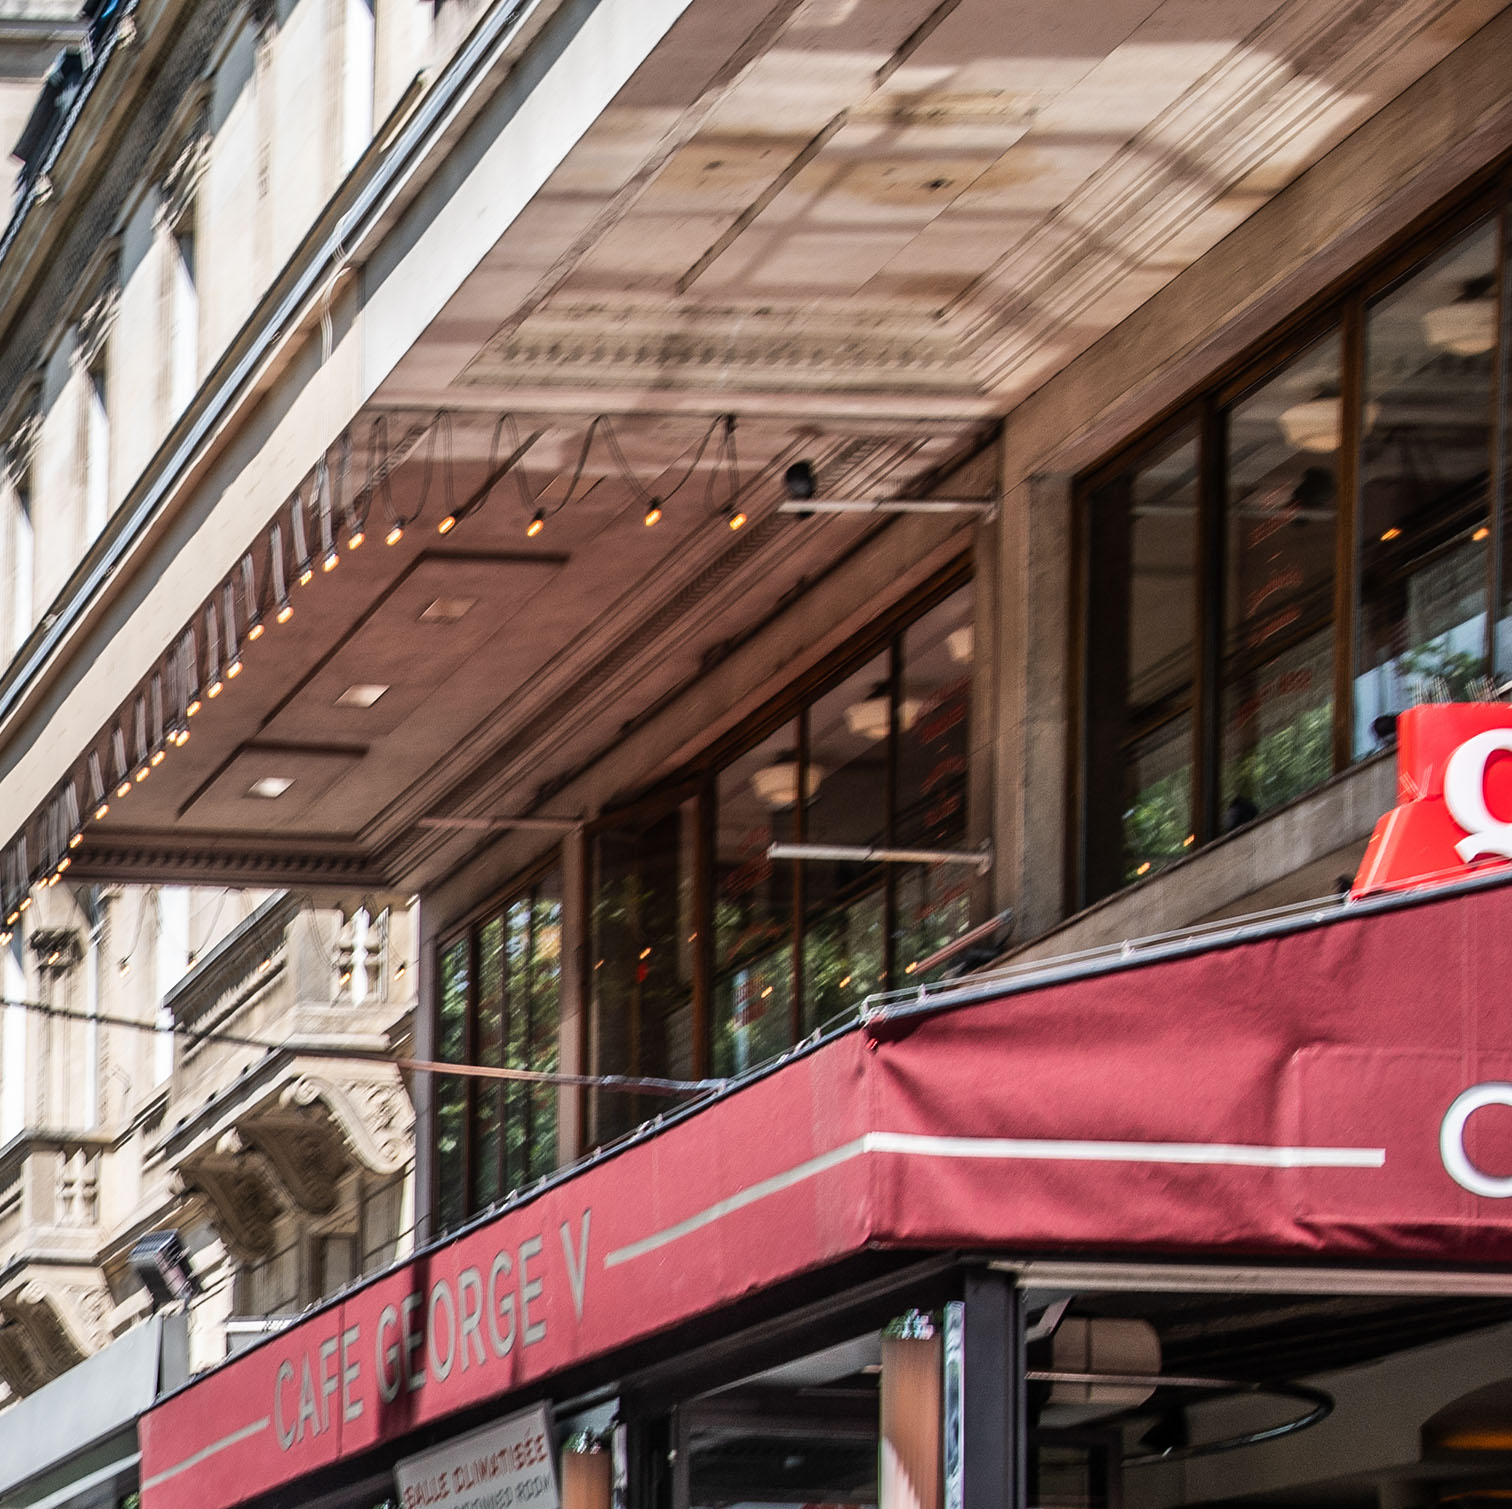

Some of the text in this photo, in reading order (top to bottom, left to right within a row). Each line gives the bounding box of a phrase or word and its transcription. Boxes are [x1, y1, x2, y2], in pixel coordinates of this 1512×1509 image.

[274, 1206, 592, 1452] CAFE GEORGE V
